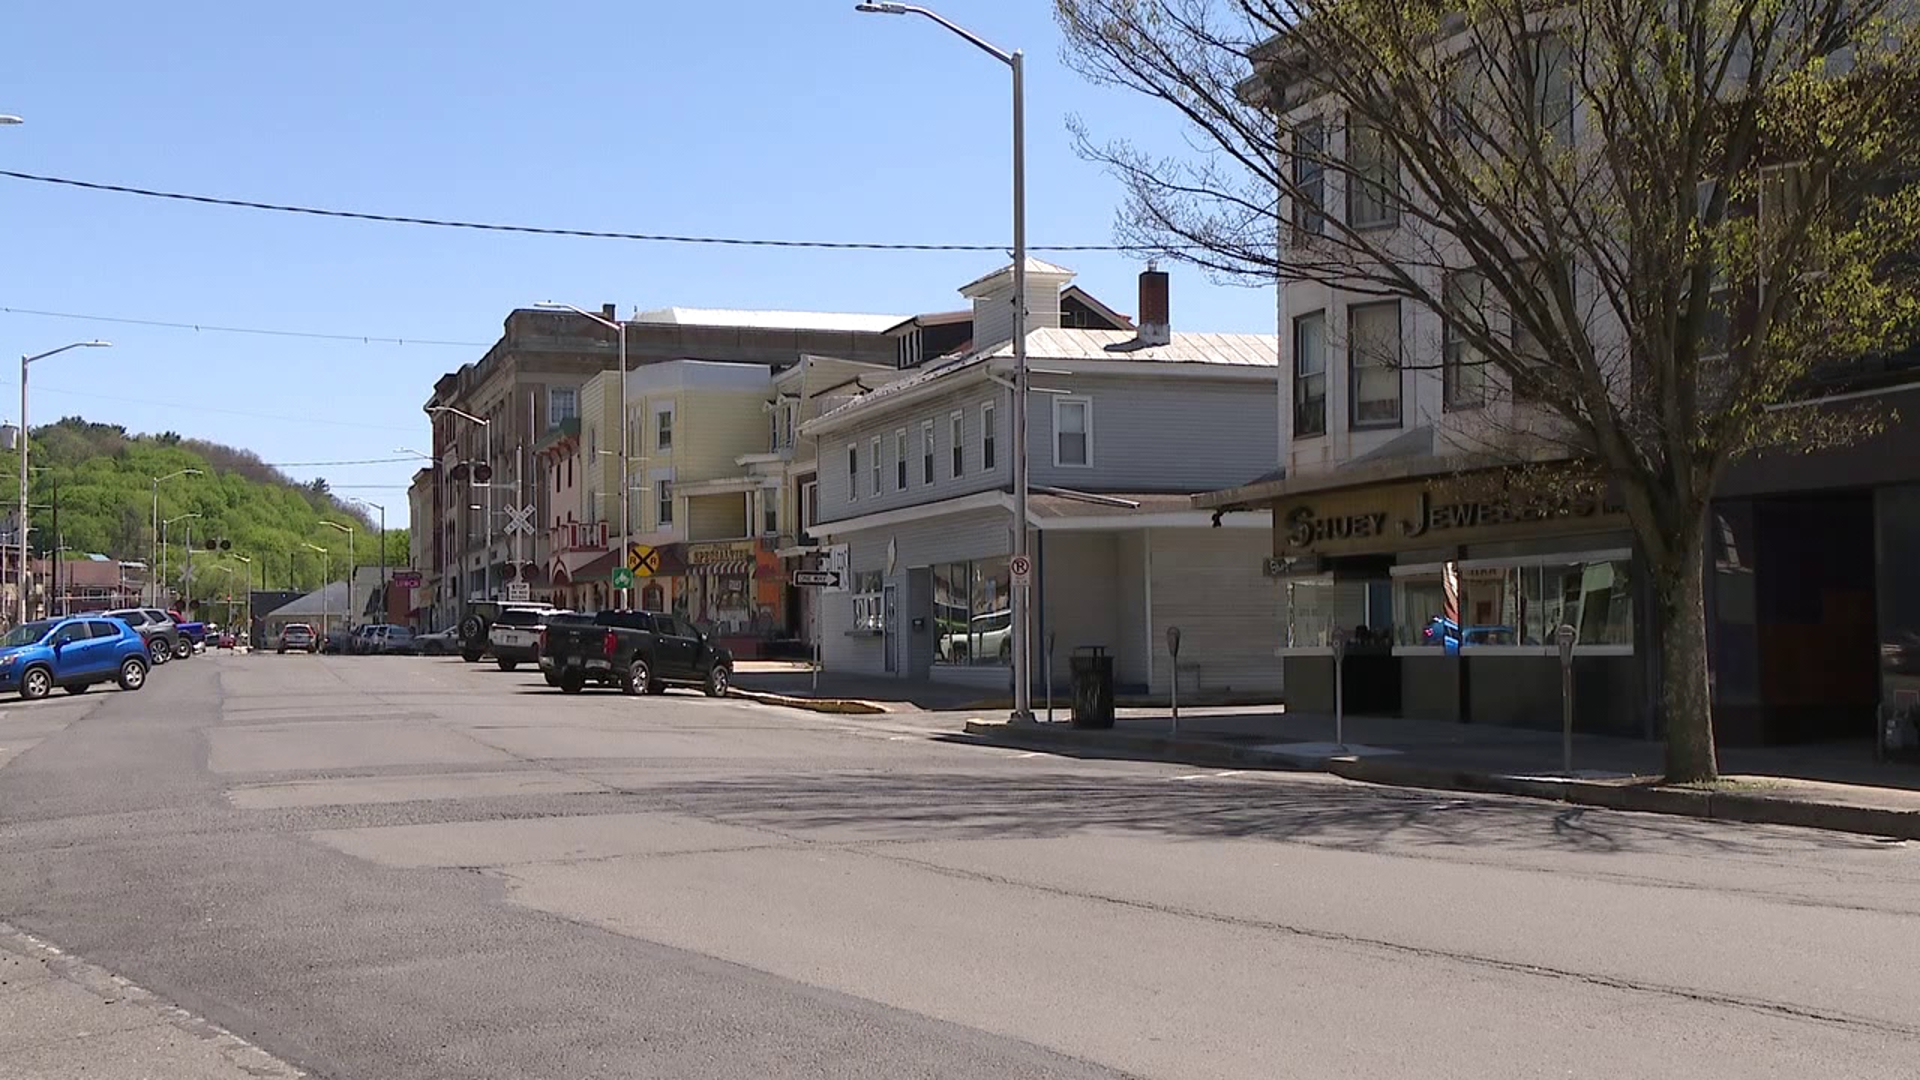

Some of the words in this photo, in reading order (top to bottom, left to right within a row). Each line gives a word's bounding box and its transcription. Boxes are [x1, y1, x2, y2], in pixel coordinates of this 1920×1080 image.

[1285, 506, 1387, 547] SHUEY
[799, 574, 812, 582] ONE
[813, 575, 827, 583] WAY
